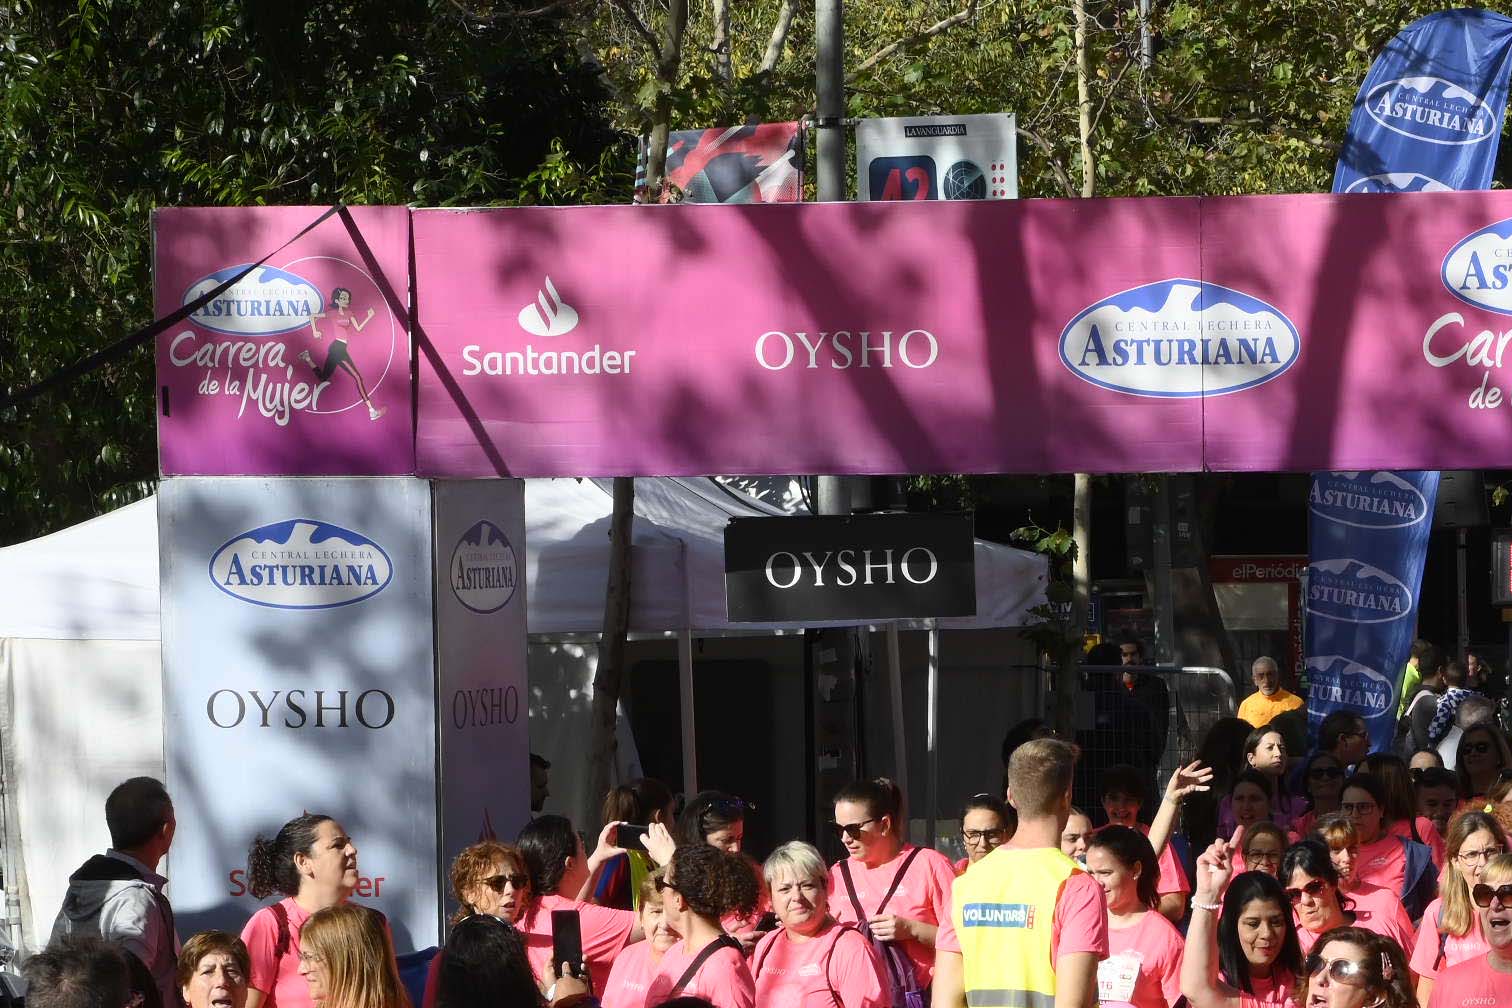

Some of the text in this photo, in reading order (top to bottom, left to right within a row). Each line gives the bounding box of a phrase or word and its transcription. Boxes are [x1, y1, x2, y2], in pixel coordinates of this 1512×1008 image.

[915, 124, 965, 136] VANGUARDIA
[1374, 91, 1485, 135] ASTURIANA
[193, 290, 313, 318] ASTURIANA
[1115, 320, 1273, 332] CENTRAL LECHERA
[169, 331, 287, 368] Carrera
[463, 345, 637, 376] Santander
[754, 330, 939, 370] OYSHO
[1078, 324, 1281, 367] ASTURIANA
[198, 364, 331, 426] de la Mujer
[1468, 370, 1503, 410] de
[1309, 479, 1417, 519] ASTURIANA
[224, 552, 379, 586] ASTURIANA
[251, 550, 373, 559] CENTRAL LECHERA
[456, 556, 513, 590] ASTURIANA
[765, 546, 938, 589] OYSHO
[1308, 584, 1402, 613] STURIANA
[206, 689, 395, 729] OYSHO
[453, 685, 519, 730] OYSHO
[1309, 682, 1386, 709] TURIANA
